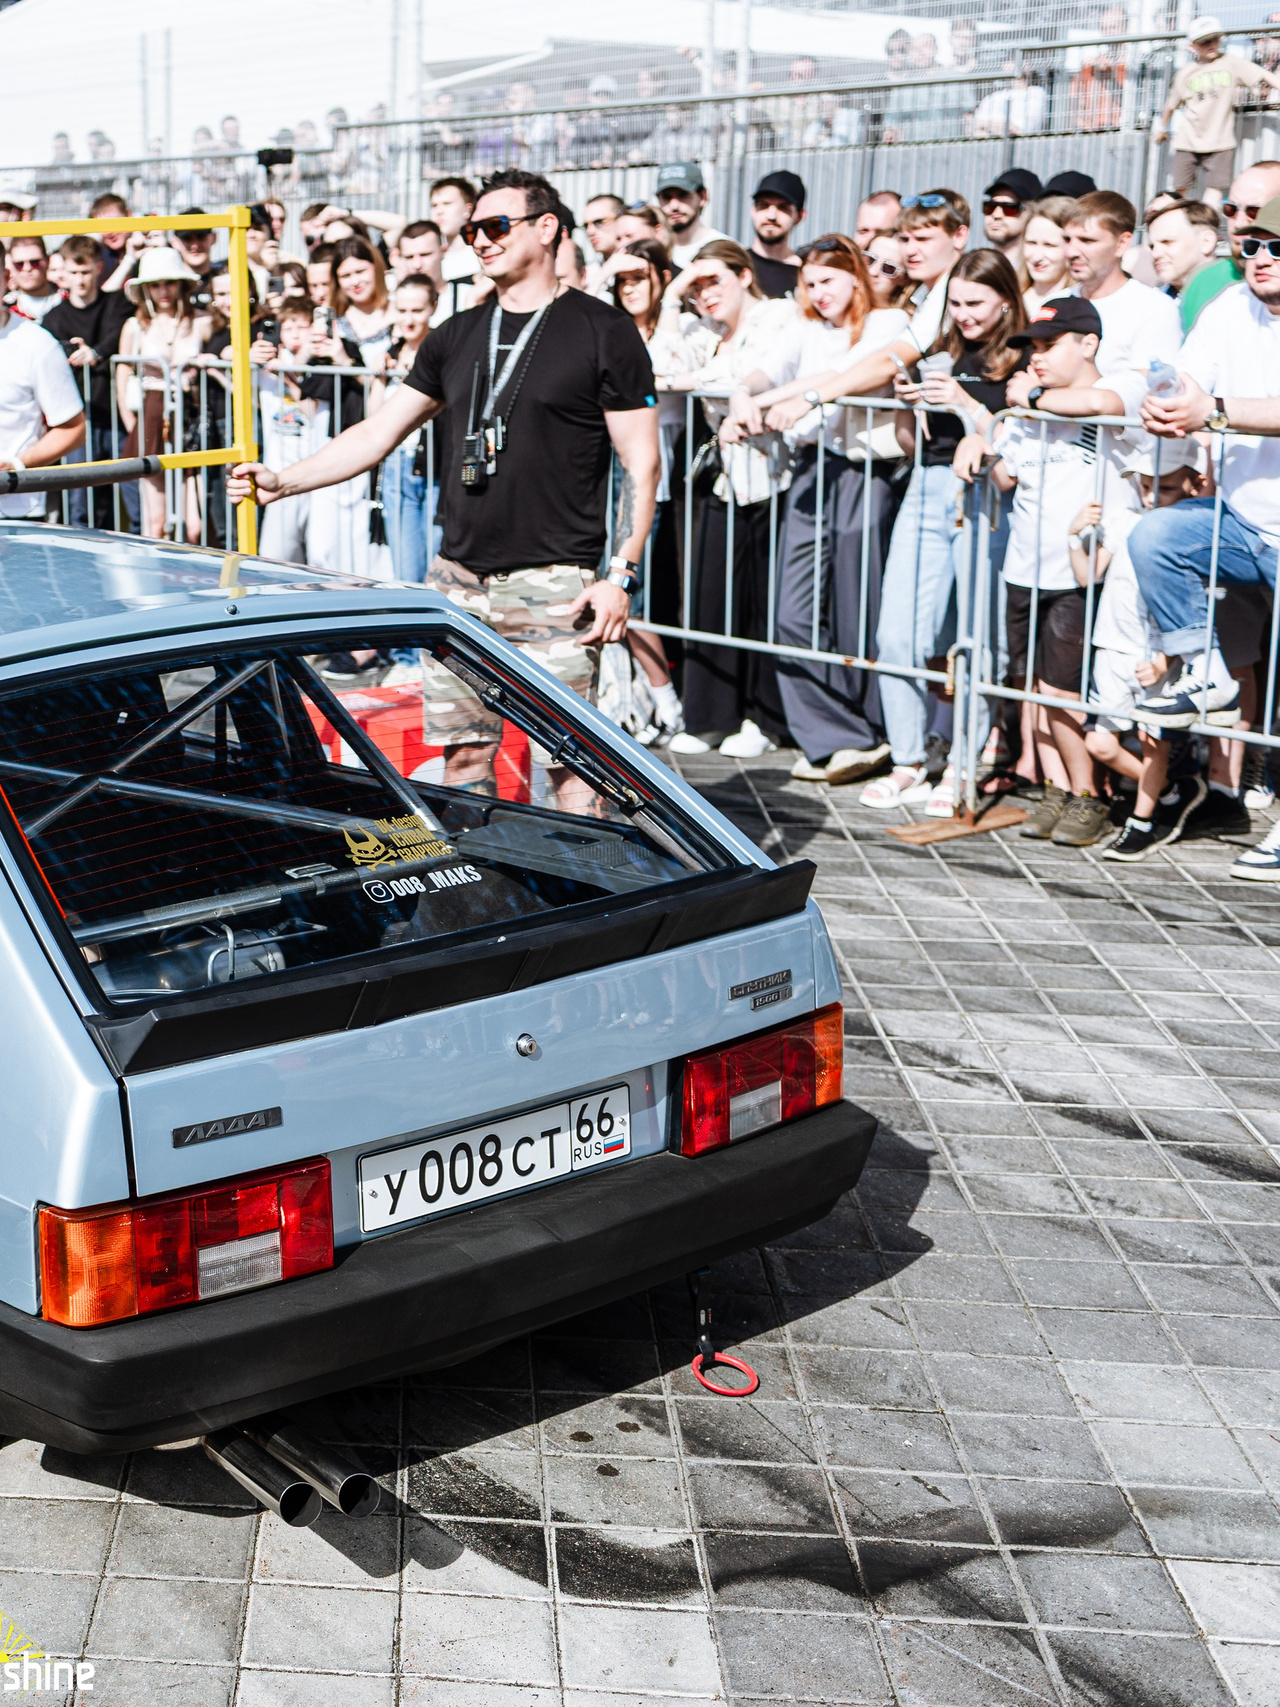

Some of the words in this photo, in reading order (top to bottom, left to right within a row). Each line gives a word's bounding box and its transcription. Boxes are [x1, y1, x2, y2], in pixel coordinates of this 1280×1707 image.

[389, 826, 436, 848] ICHIBAN
[397, 840, 452, 863] GRAPHICS
[389, 864, 483, 897] 008_MAKS
[733, 971, 787, 996] СПУТНИК
[755, 992, 778, 1007] 1500
[184, 1111, 267, 1143] ЛАДА
[575, 1097, 615, 1144] 66
[573, 1141, 603, 1163] RUS
